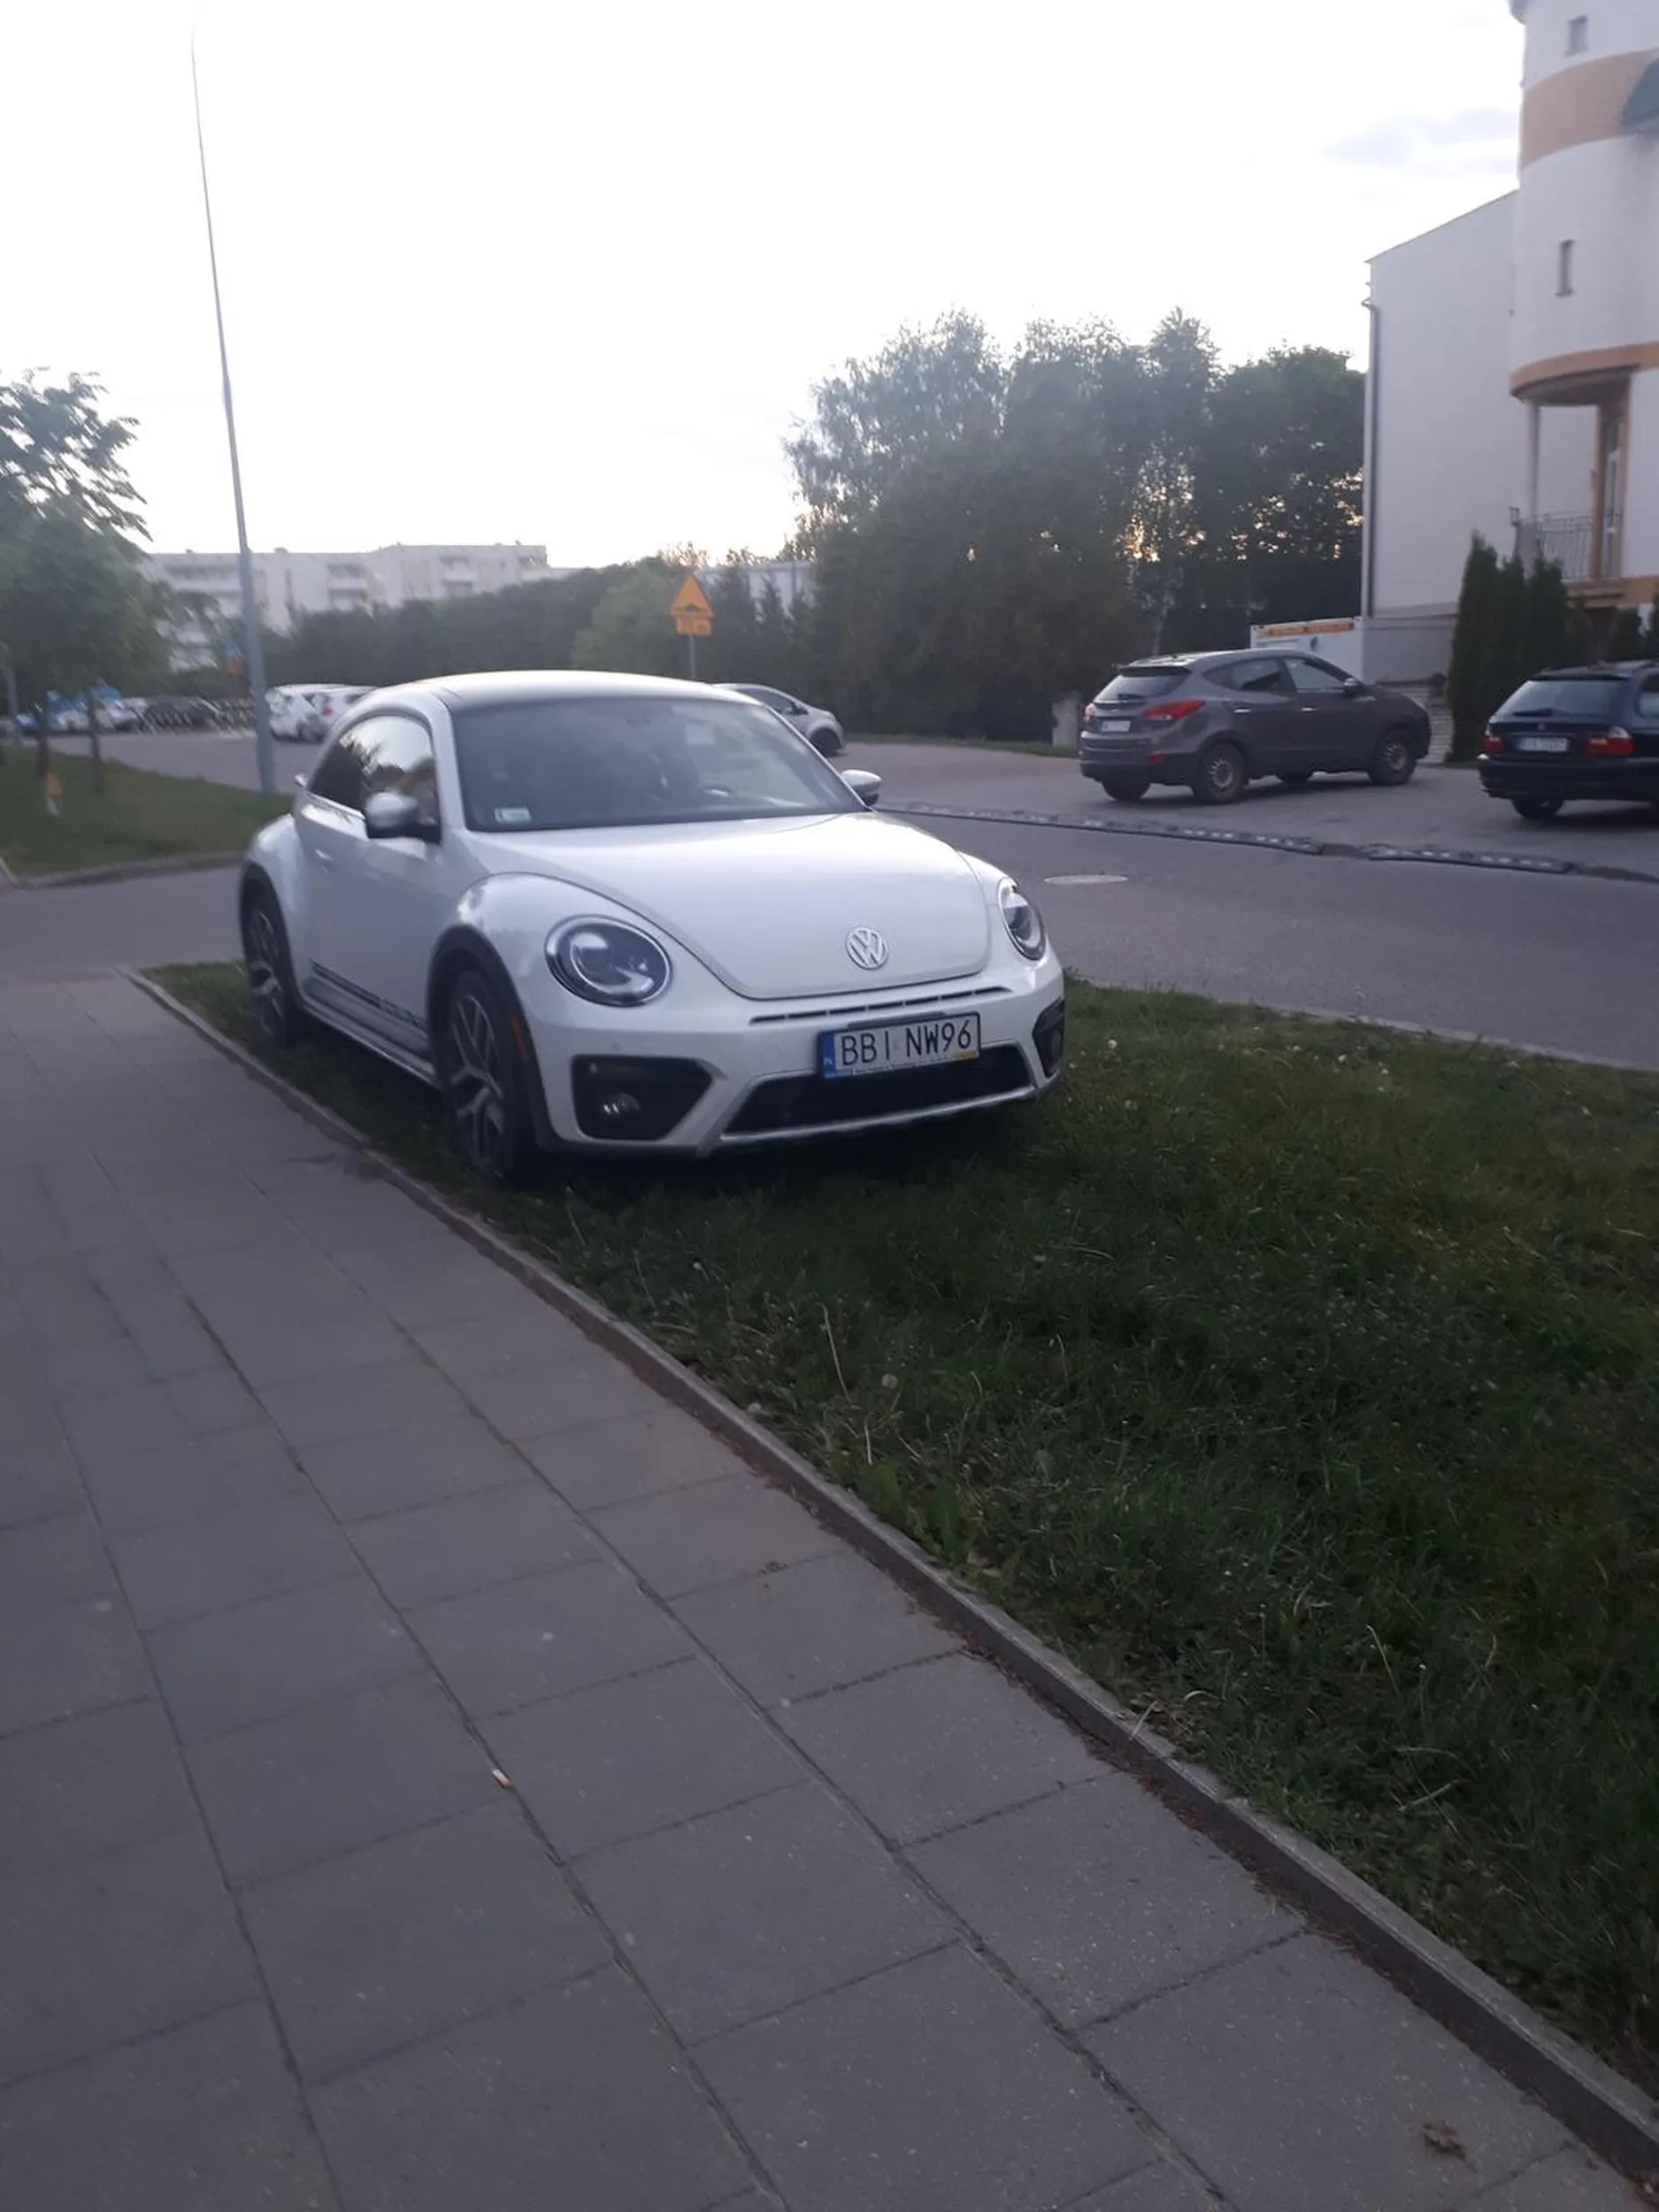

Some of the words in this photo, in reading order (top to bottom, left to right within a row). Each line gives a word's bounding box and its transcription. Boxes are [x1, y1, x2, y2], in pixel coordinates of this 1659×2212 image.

[847, 927, 887, 969] VW
[841, 1030, 889, 1066] BBI
[905, 1019, 972, 1058] NW96
